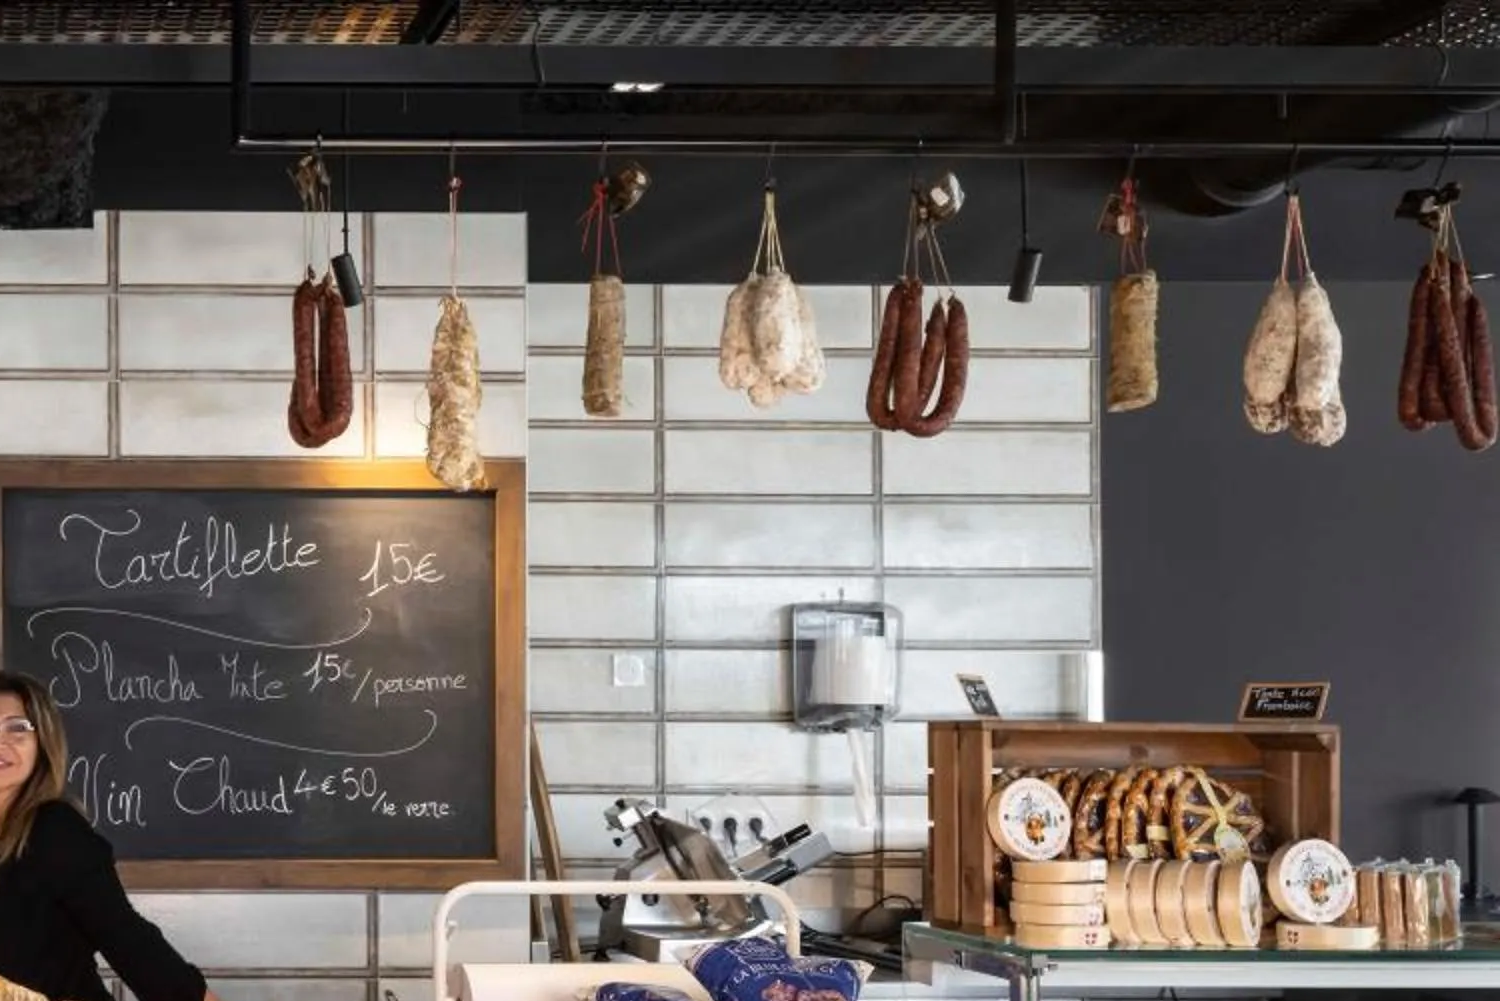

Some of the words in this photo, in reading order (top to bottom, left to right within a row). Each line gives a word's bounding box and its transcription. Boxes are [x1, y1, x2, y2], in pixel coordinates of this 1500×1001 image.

[60, 509, 320, 598] Tartiflette
[358, 541, 445, 597] 15€
[49, 631, 203, 709] Plancha
[68, 754, 147, 828] Vin
[169, 755, 295, 816] Chaud
